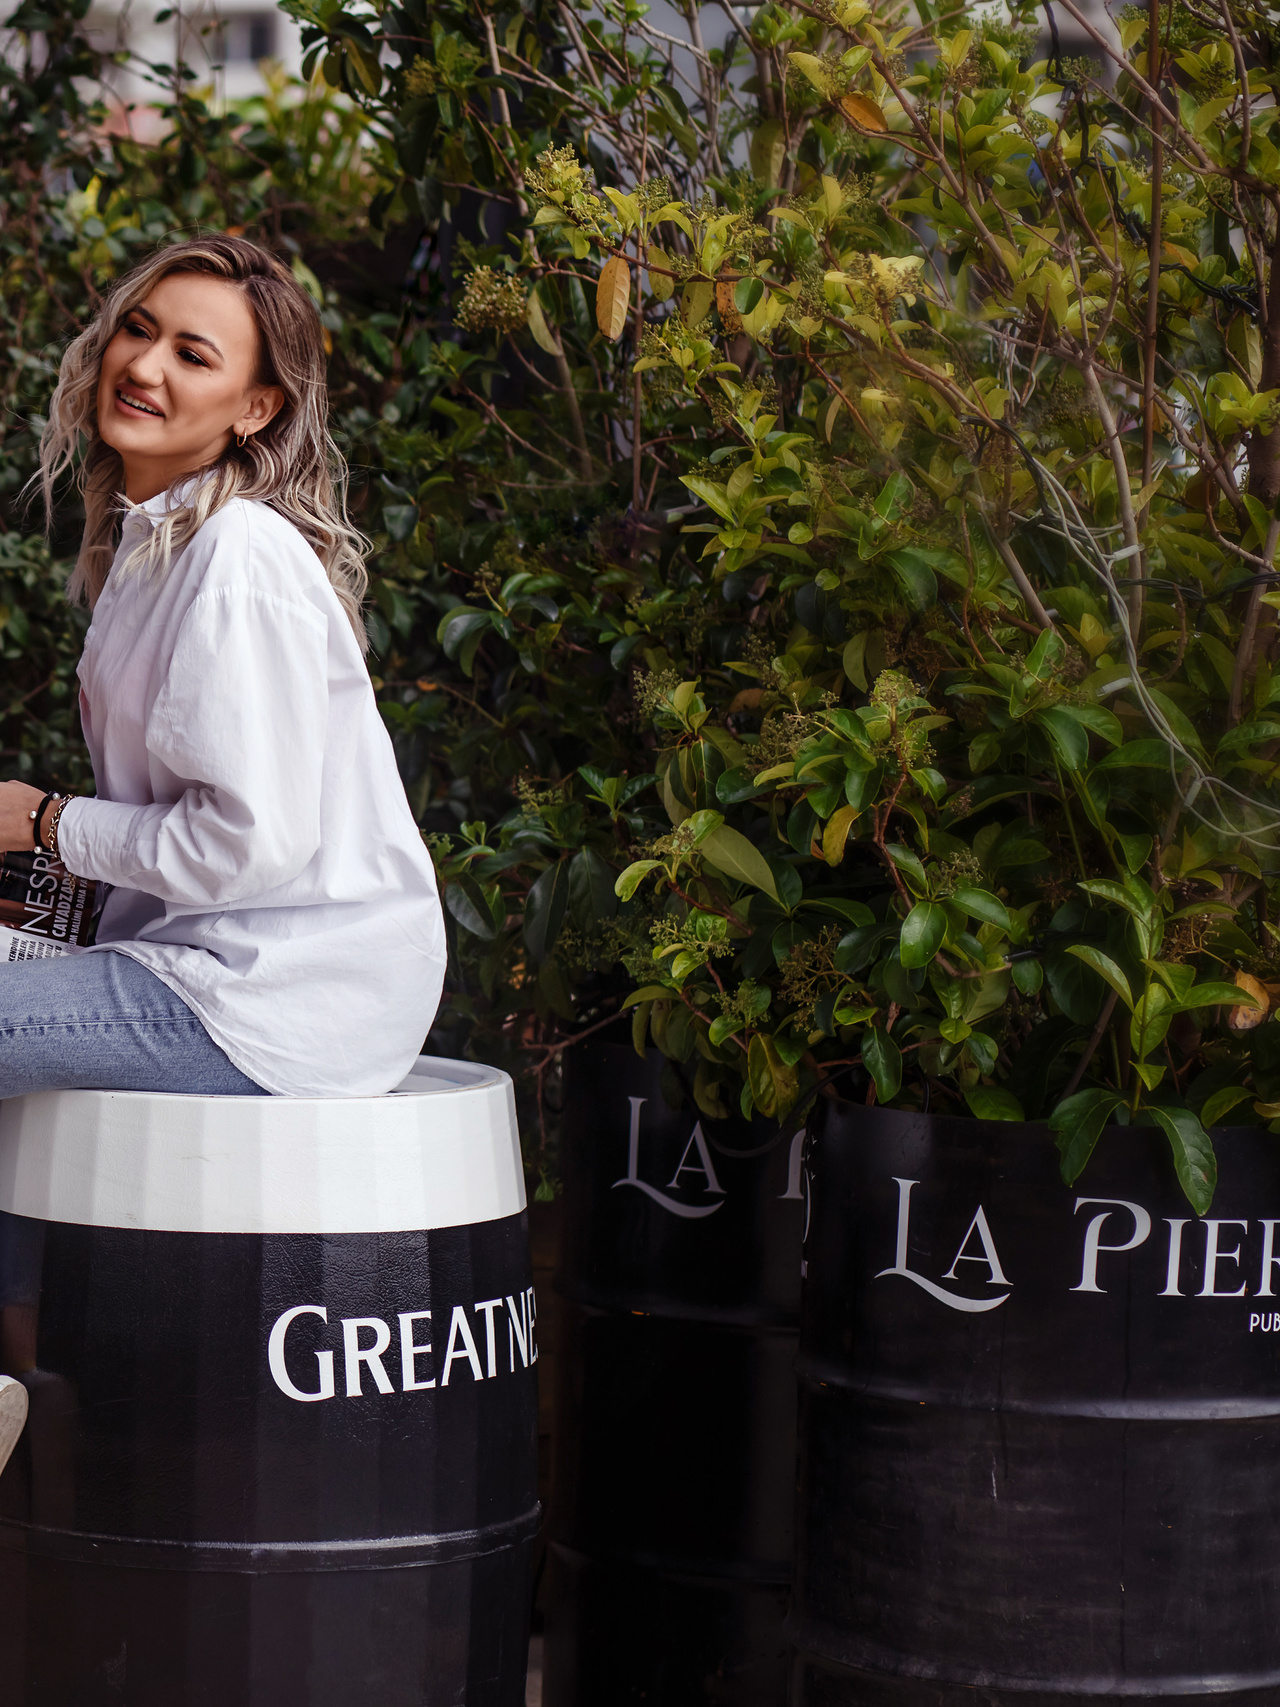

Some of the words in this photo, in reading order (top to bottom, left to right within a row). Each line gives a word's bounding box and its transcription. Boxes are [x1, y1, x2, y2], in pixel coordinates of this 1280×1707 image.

[75, 889, 87, 908] DAHA
[80, 878, 88, 888] FA
[611, 1096, 727, 1218] LA
[873, 1176, 1014, 1313] LA
